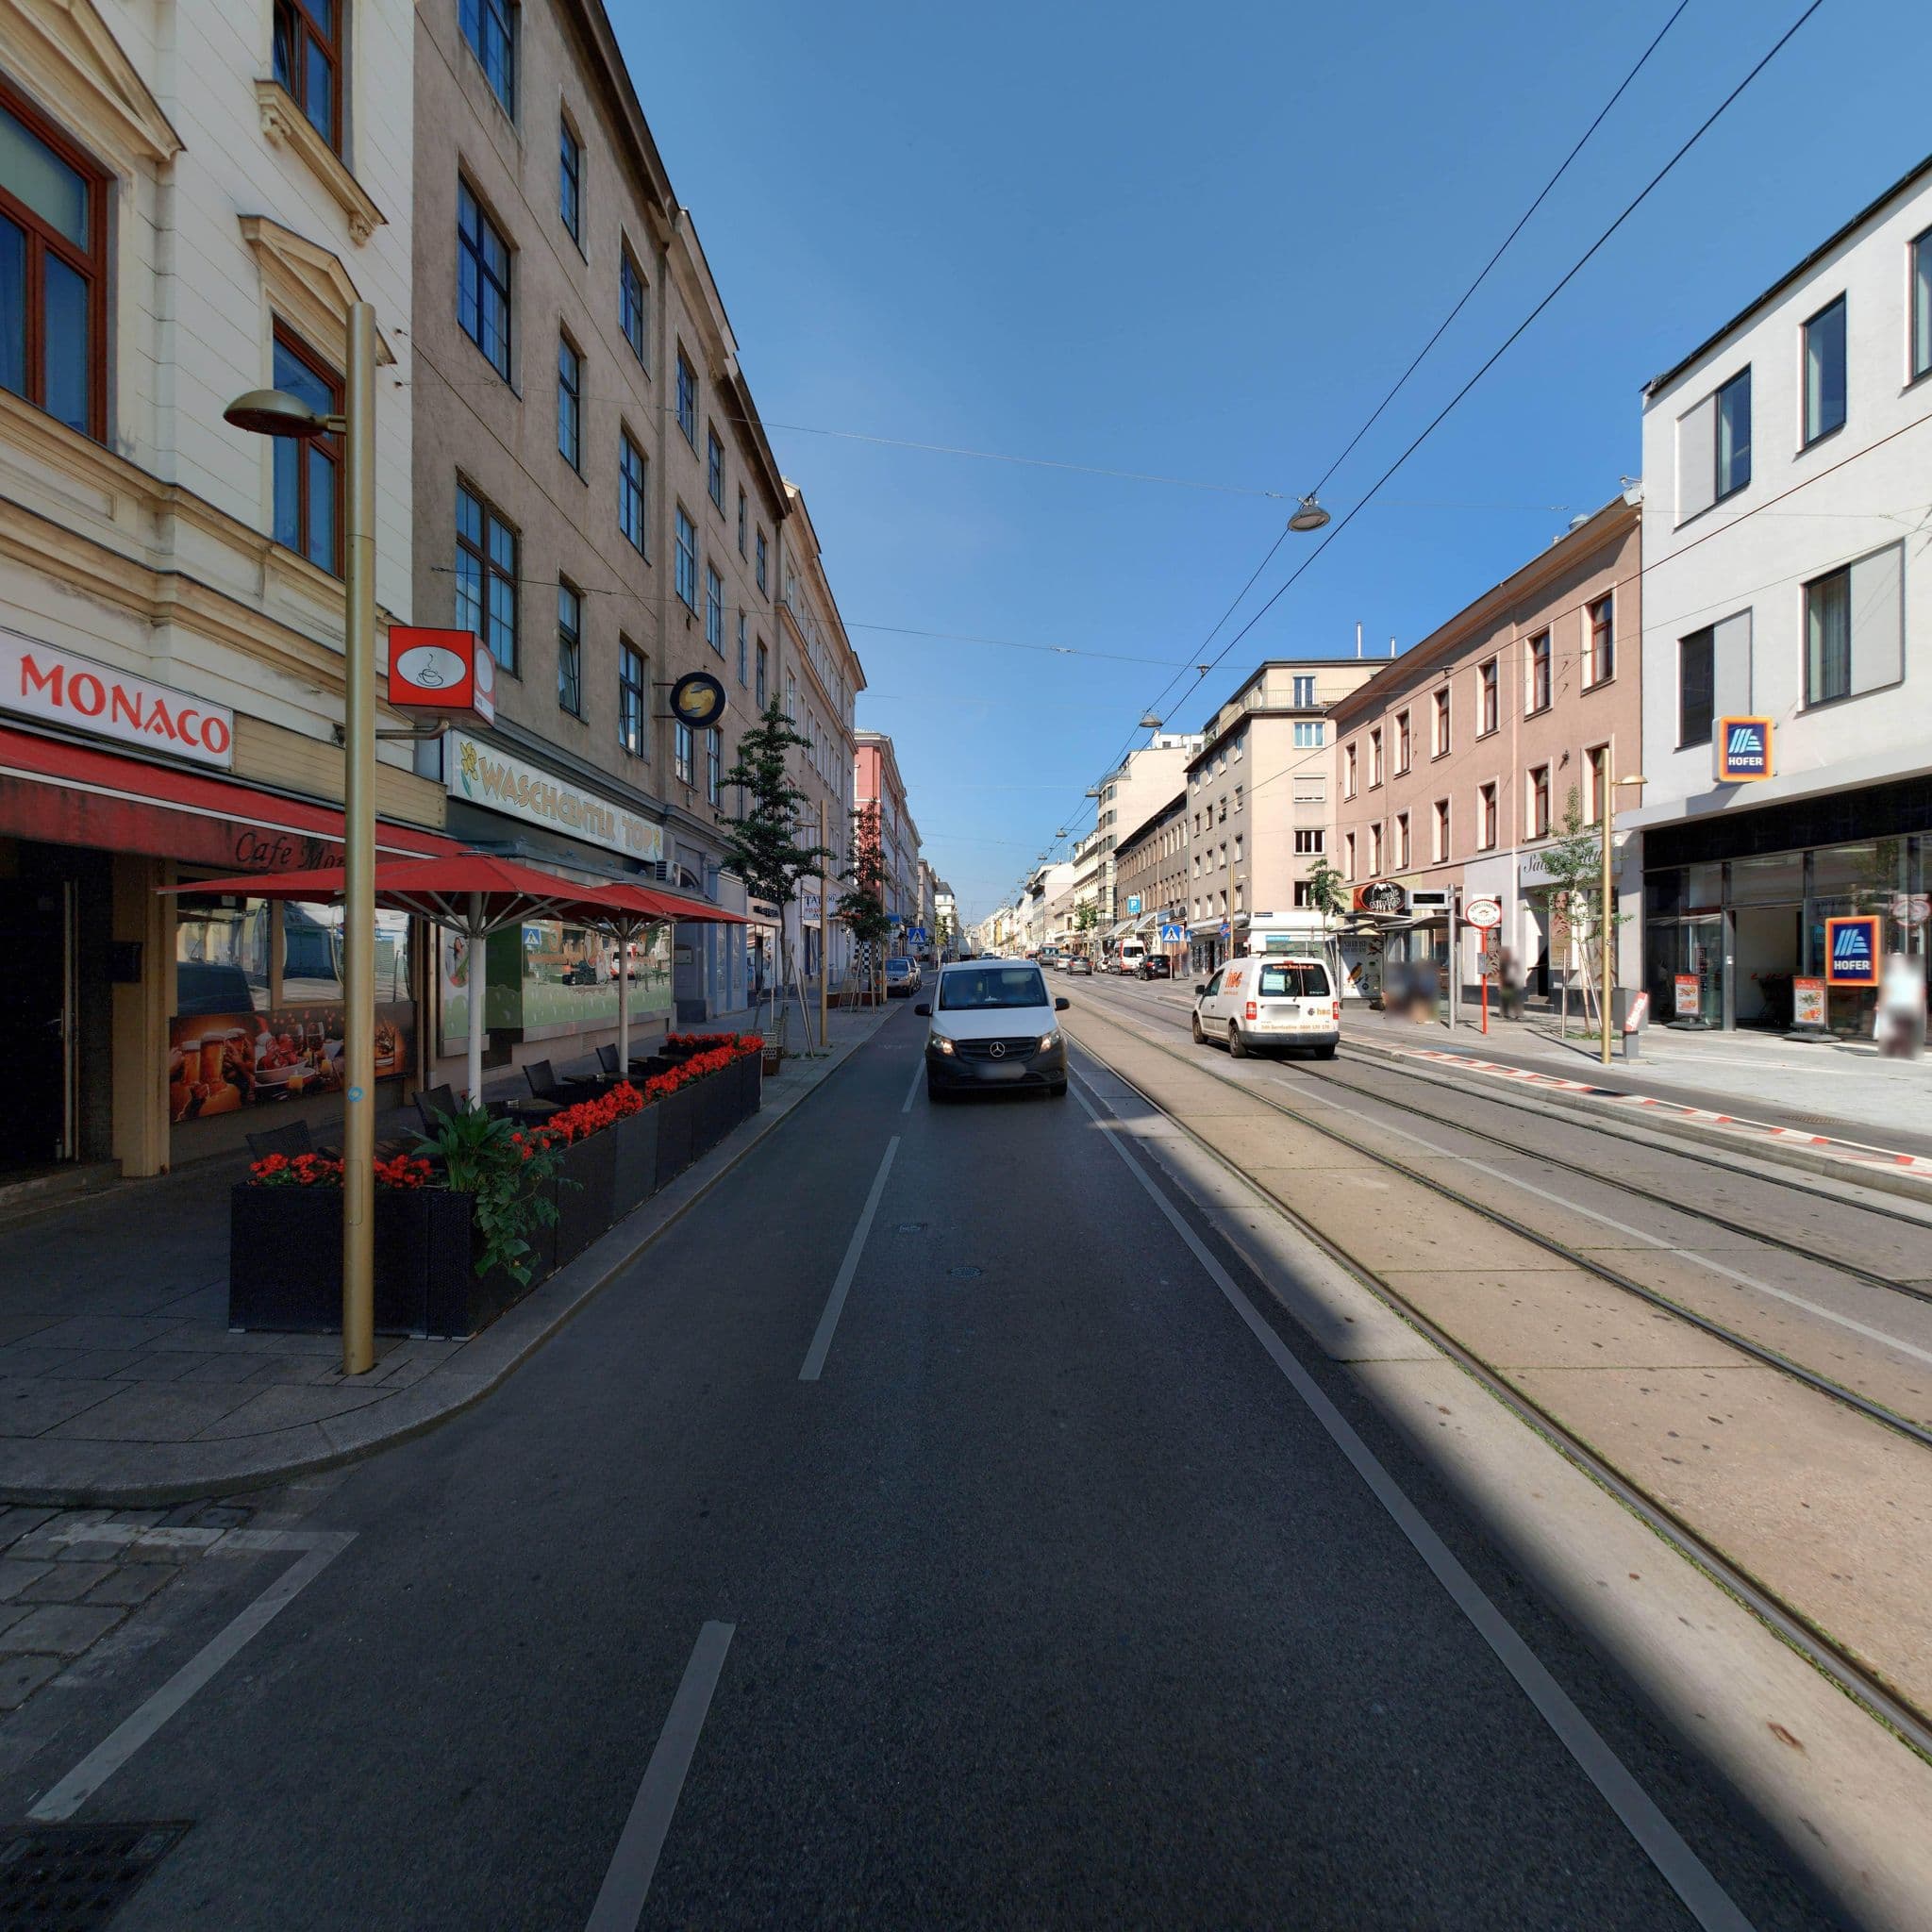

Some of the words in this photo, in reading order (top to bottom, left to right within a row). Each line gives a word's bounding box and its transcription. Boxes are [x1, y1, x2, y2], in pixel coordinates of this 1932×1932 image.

[20, 653, 231, 754] MONACO
[1728, 757, 1763, 766] HOFER
[478, 757, 616, 842] WASCHCENTER
[621, 814, 654, 854] TOP
[236, 832, 291, 869] Cafe
[1130, 900, 1137, 909] P
[1834, 960, 1872, 971] HOFER
